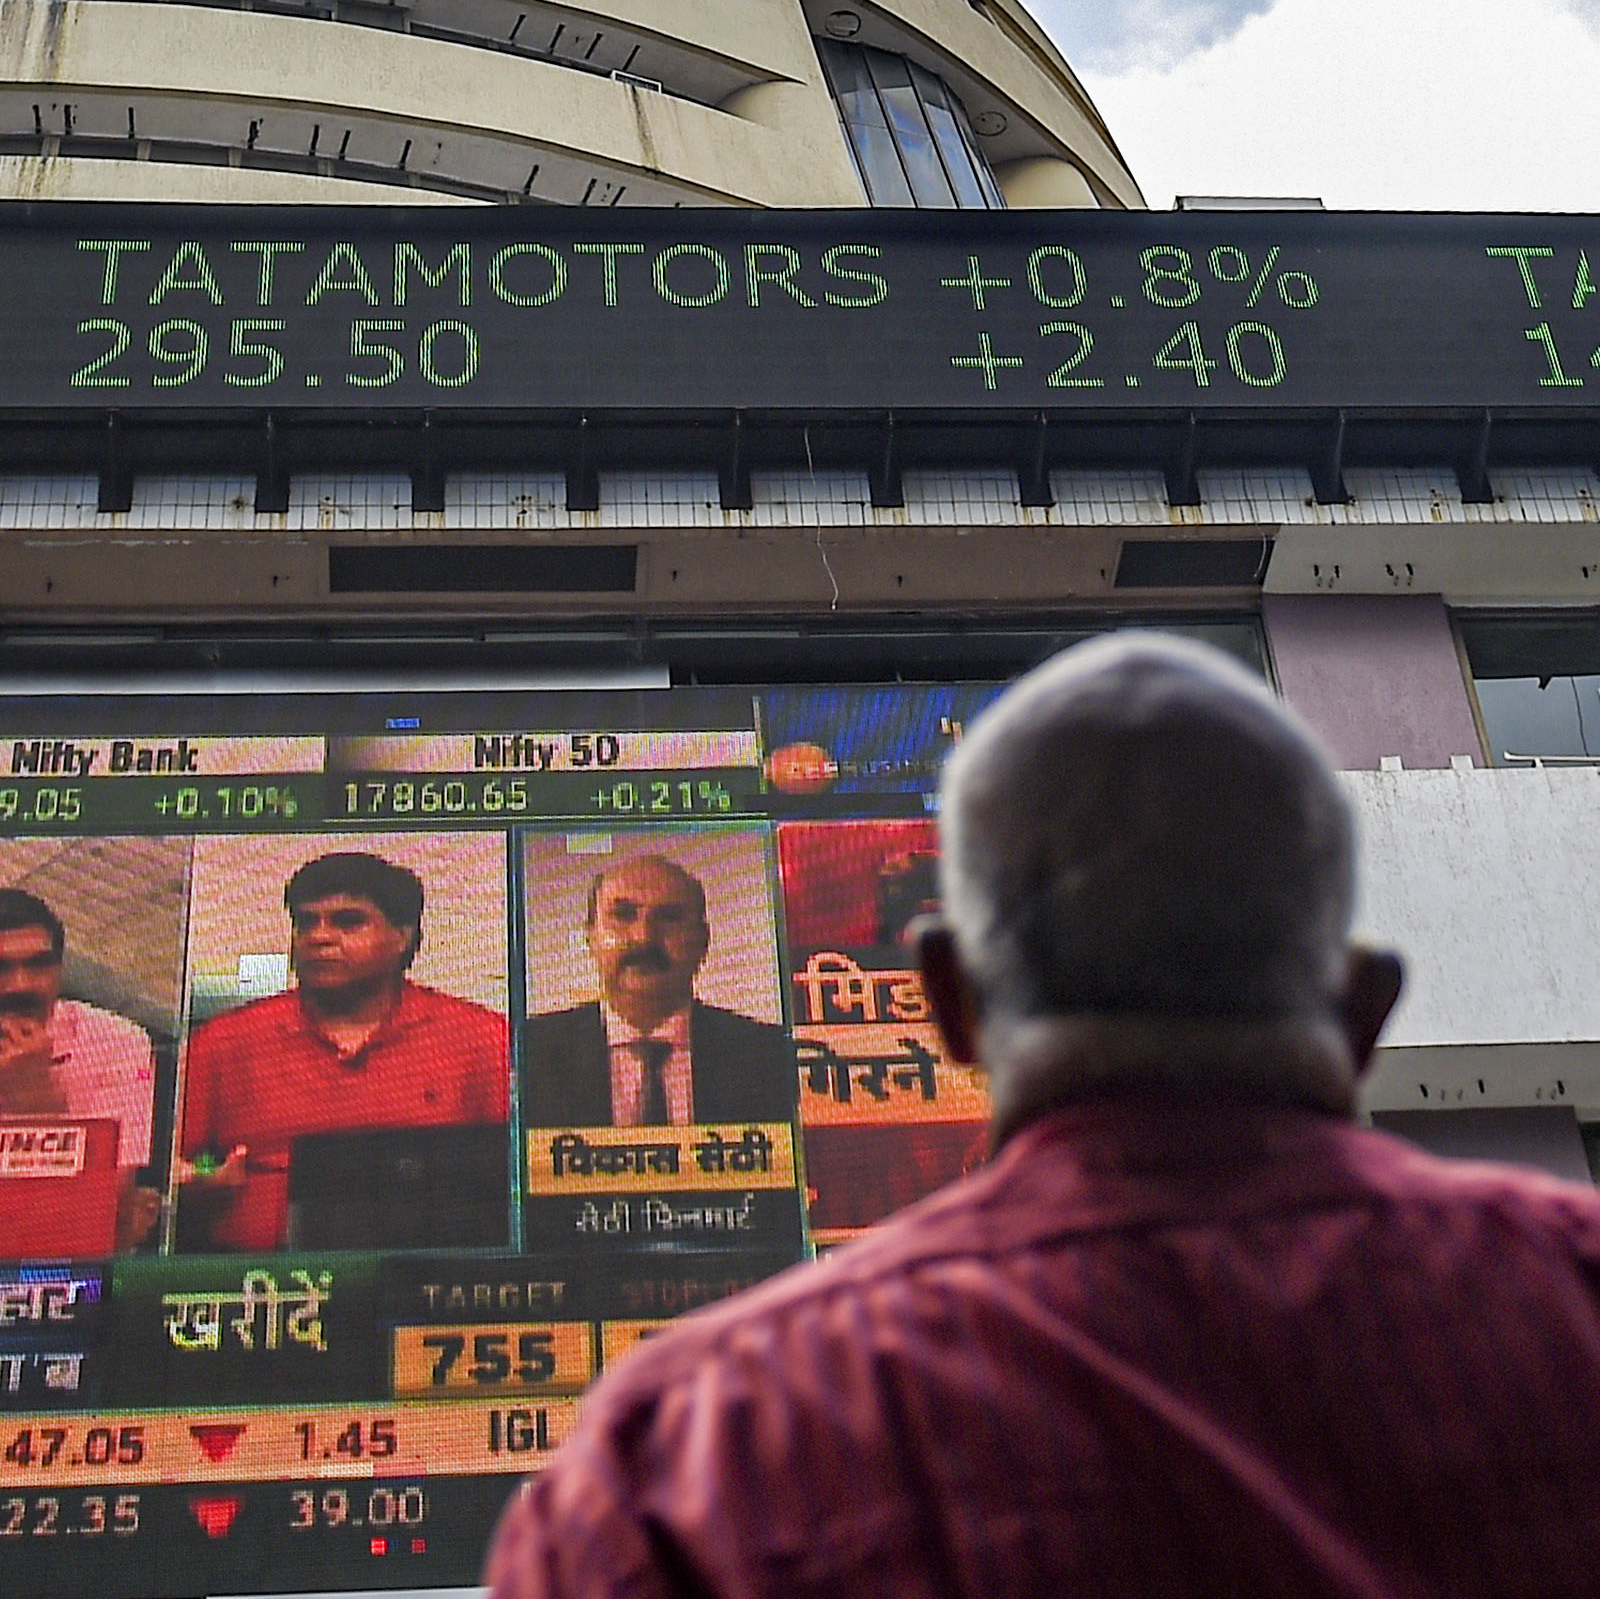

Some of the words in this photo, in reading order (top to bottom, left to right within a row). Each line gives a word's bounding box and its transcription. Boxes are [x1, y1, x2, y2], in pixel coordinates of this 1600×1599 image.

[74, 241, 891, 309] TATAMOTORS
[938, 244, 1322, 313] +0.8%
[68, 319, 479, 390] 295.50
[948, 319, 1292, 390] +2.40
[11, 741, 99, 776] Nifty
[108, 740, 199, 773] Bank
[474, 735, 557, 770] Nifty
[154, 786, 298, 820] +0.10%
[345, 779, 529, 813] 17860.65
[590, 781, 732, 810] +0.21%
[550, 1133, 680, 1176] विकास
[690, 1130, 773, 1172] सेठी
[162, 1270, 334, 1352] खरीदें
[423, 1281, 566, 1309] TARGET
[423, 1331, 557, 1386] 755
[6, 1426, 145, 1467] 47.05
[296, 1420, 397, 1460] 1.45
[290, 1487, 425, 1529] 39.00
